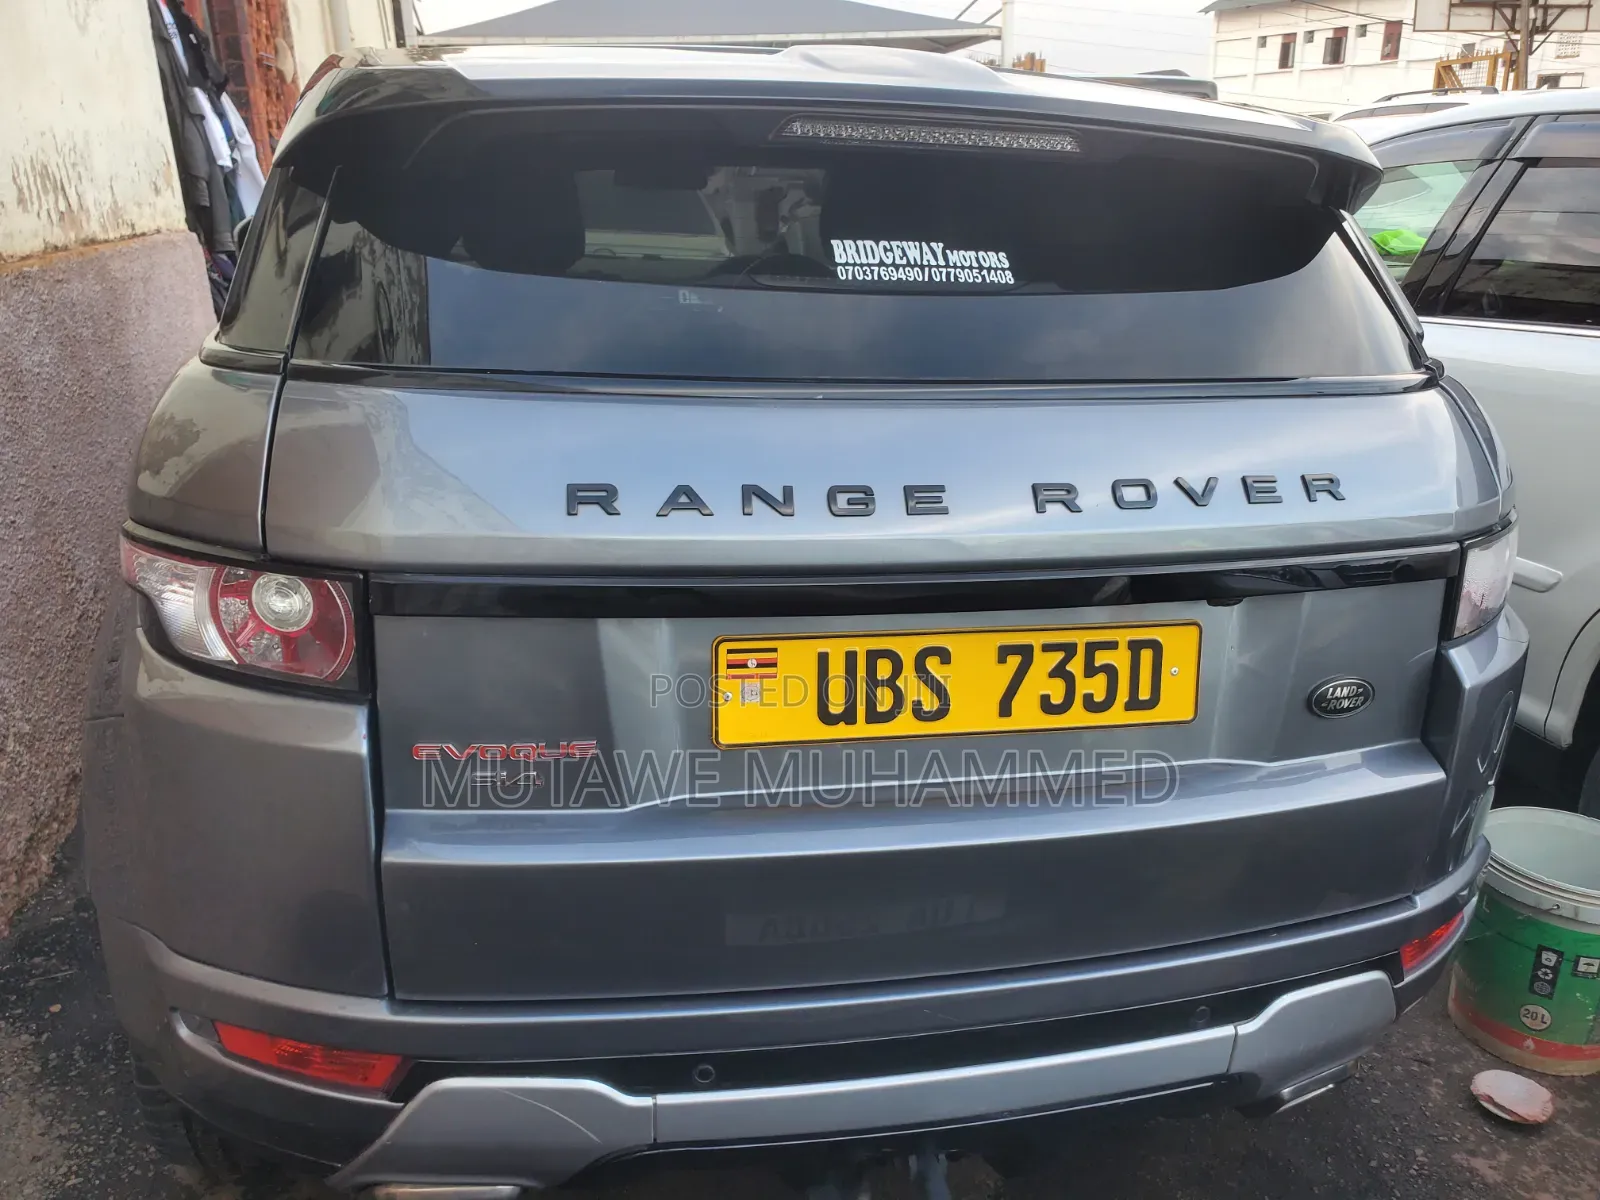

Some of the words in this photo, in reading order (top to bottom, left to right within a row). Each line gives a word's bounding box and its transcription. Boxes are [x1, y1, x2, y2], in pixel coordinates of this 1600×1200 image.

[830, 239, 944, 266] BRIDGEWAY
[946, 249, 1010, 269] MOTORS
[566, 482, 950, 518] RANGE
[1031, 472, 1347, 514] ROVER
[816, 644, 953, 727] UBS
[996, 637, 1164, 719] 735D
[1327, 685, 1357, 699] LAND
[1327, 696, 1364, 710] ROVER
[412, 739, 599, 763] EVOQUE
[1522, 1008, 1538, 1021] 20
[1540, 1013, 1548, 1025] L
